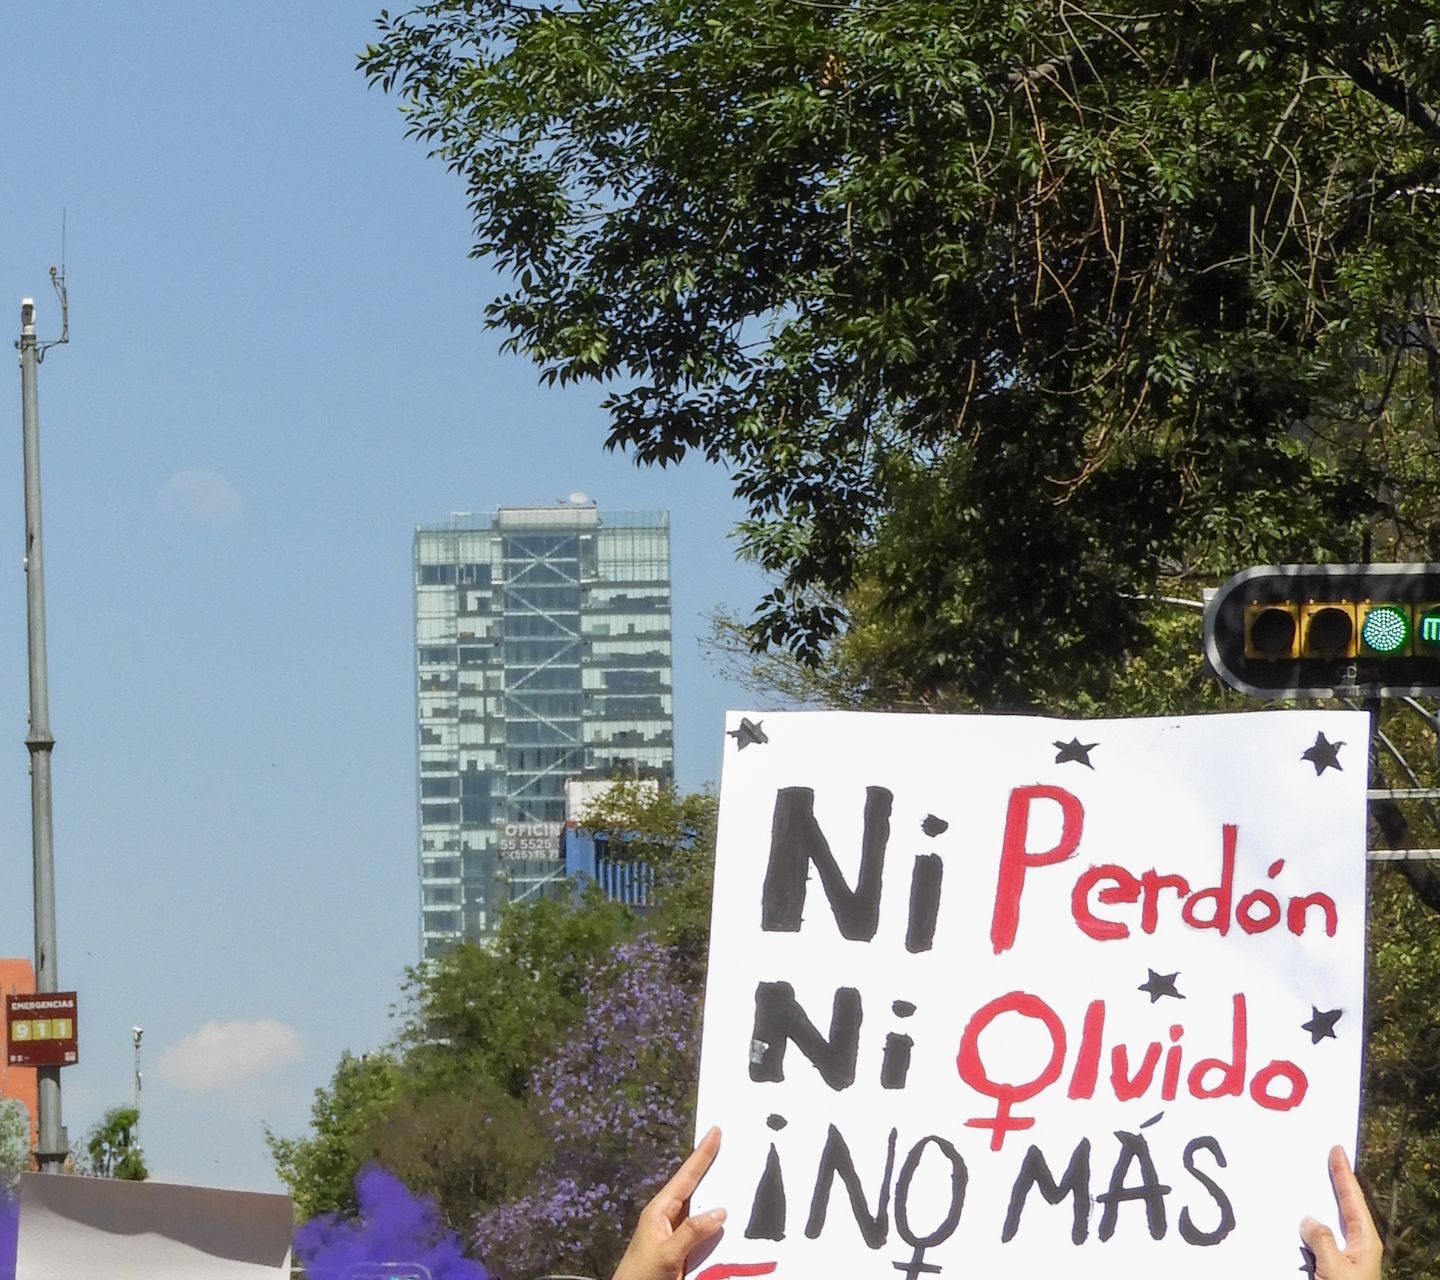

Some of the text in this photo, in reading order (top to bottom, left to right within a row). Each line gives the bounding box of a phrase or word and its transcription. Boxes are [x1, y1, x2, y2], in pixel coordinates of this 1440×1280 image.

[762, 782, 1338, 955] Ni Perdón
[11, 1000, 74, 1011] EMERGENCIAS
[749, 981, 1308, 1151] Ni Olvido
[1002, 1112, 1236, 1248] MÁS
